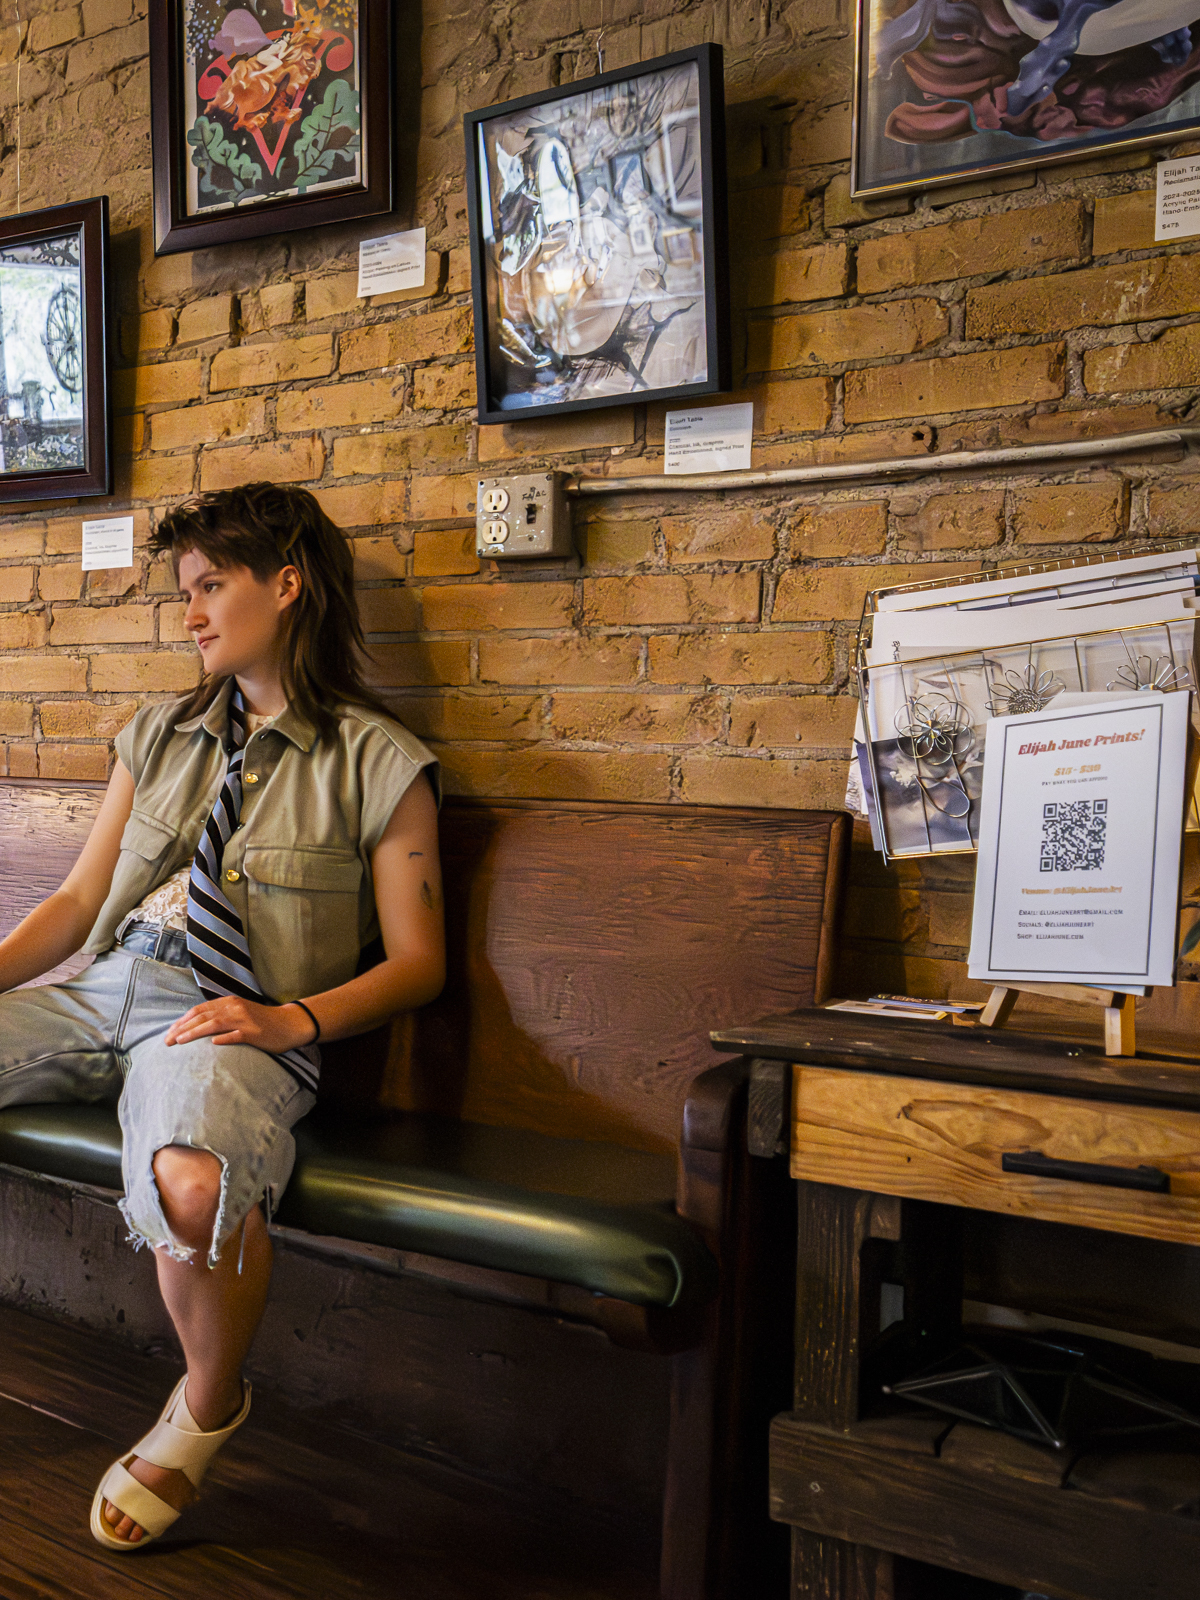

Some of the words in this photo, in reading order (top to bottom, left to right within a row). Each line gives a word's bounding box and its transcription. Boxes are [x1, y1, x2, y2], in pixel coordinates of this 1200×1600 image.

[1163, 167, 1187, 178] Elijah
[1018, 740, 1056, 756] Elijah
[1058, 738, 1092, 750] June
[1094, 728, 1146, 746] Prints!
